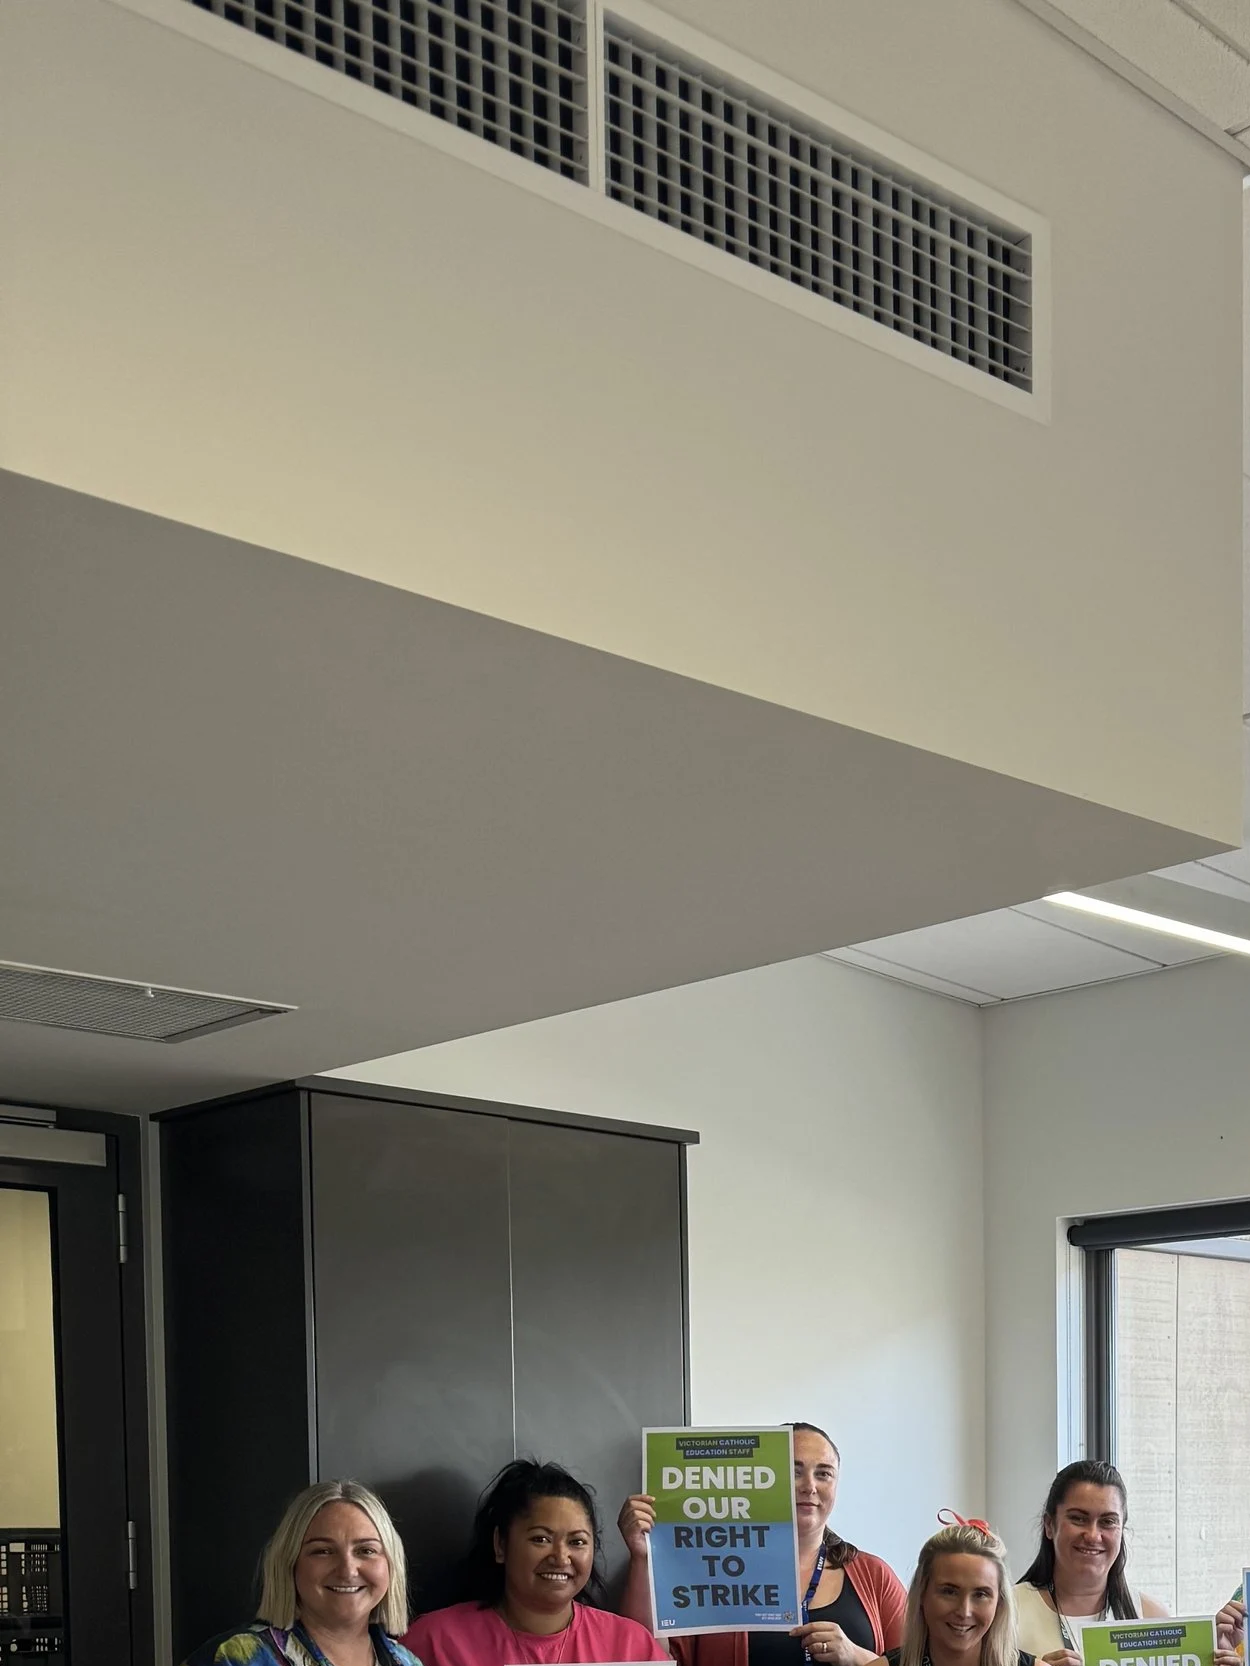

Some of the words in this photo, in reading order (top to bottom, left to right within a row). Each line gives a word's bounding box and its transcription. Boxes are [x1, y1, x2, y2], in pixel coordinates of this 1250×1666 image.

[663, 1466, 775, 1490] DENIED
[683, 1497, 750, 1519] OUR
[675, 1526, 769, 1548] RIGHT
[702, 1555, 745, 1577] TO
[672, 1585, 779, 1608] STRIKE
[1120, 1640, 1158, 1648] EDUCATION
[1150, 1629, 1182, 1637] CATHOLIC
